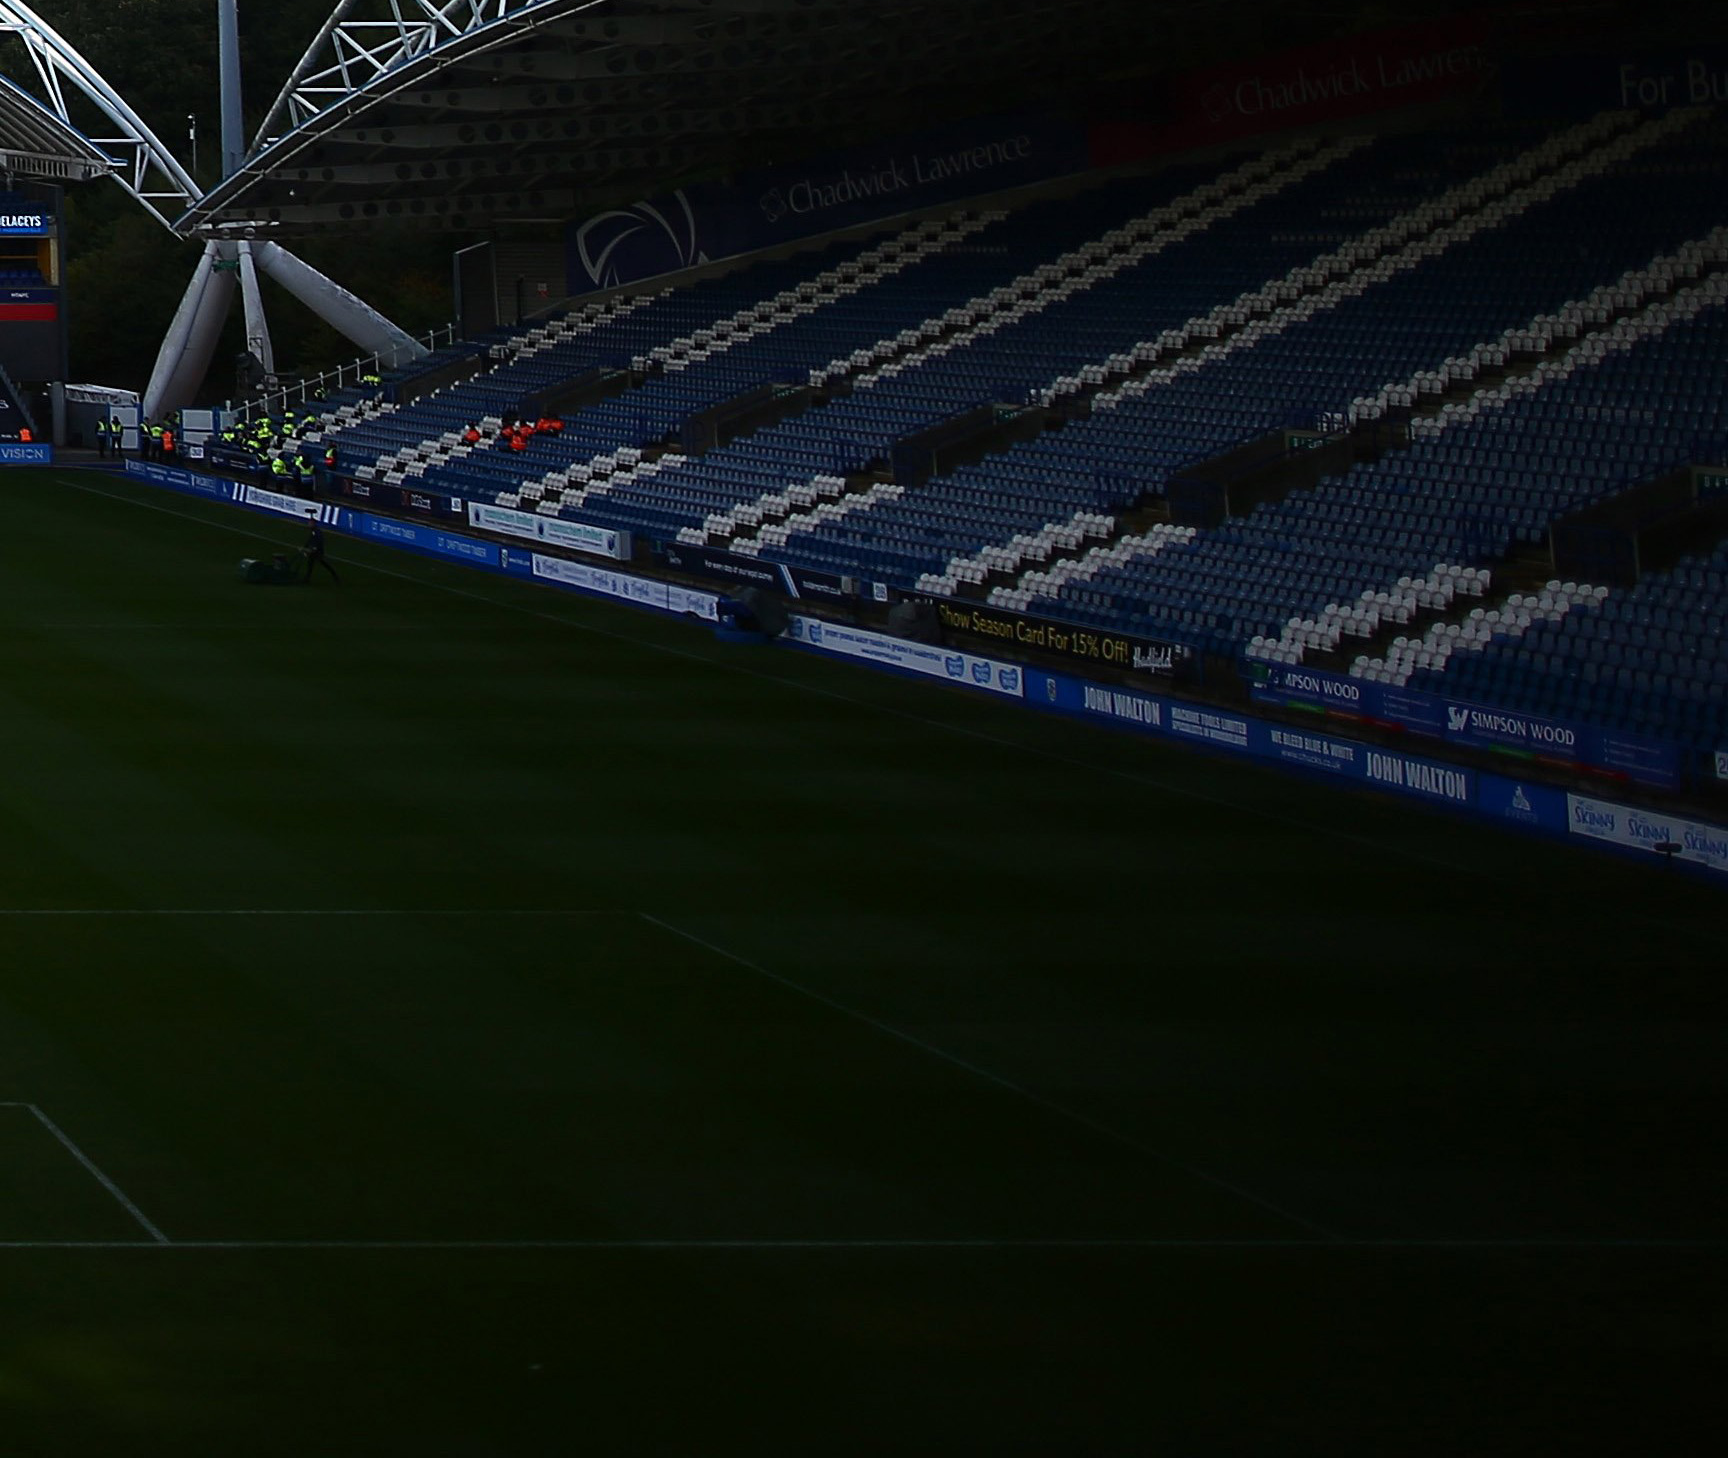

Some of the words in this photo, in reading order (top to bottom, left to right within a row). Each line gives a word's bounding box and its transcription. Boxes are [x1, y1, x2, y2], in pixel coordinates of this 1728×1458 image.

[1620, 63, 1674, 107] For
[789, 156, 909, 213] Chadwick
[913, 134, 1032, 184] Lawrence
[0, 448, 44, 459] VISION
[938, 603, 970, 630] Show
[973, 610, 1014, 639] Season
[1016, 620, 1044, 646] Card
[1047, 626, 1069, 652] For
[1071, 631, 1100, 658] 15%
[1102, 636, 1130, 664] Off!
[1084, 686, 1112, 713] JOHN
[1113, 692, 1161, 725] WALTON
[1324, 680, 1360, 701] WOOD
[1471, 710, 1528, 738] SIMPSON
[1529, 722, 1575, 746] WOOD
[1366, 751, 1403, 785] JOHN
[1405, 761, 1467, 801] WALTON
[1575, 805, 1615, 832] SKINNY
[1628, 817, 1670, 843] SKINNY
